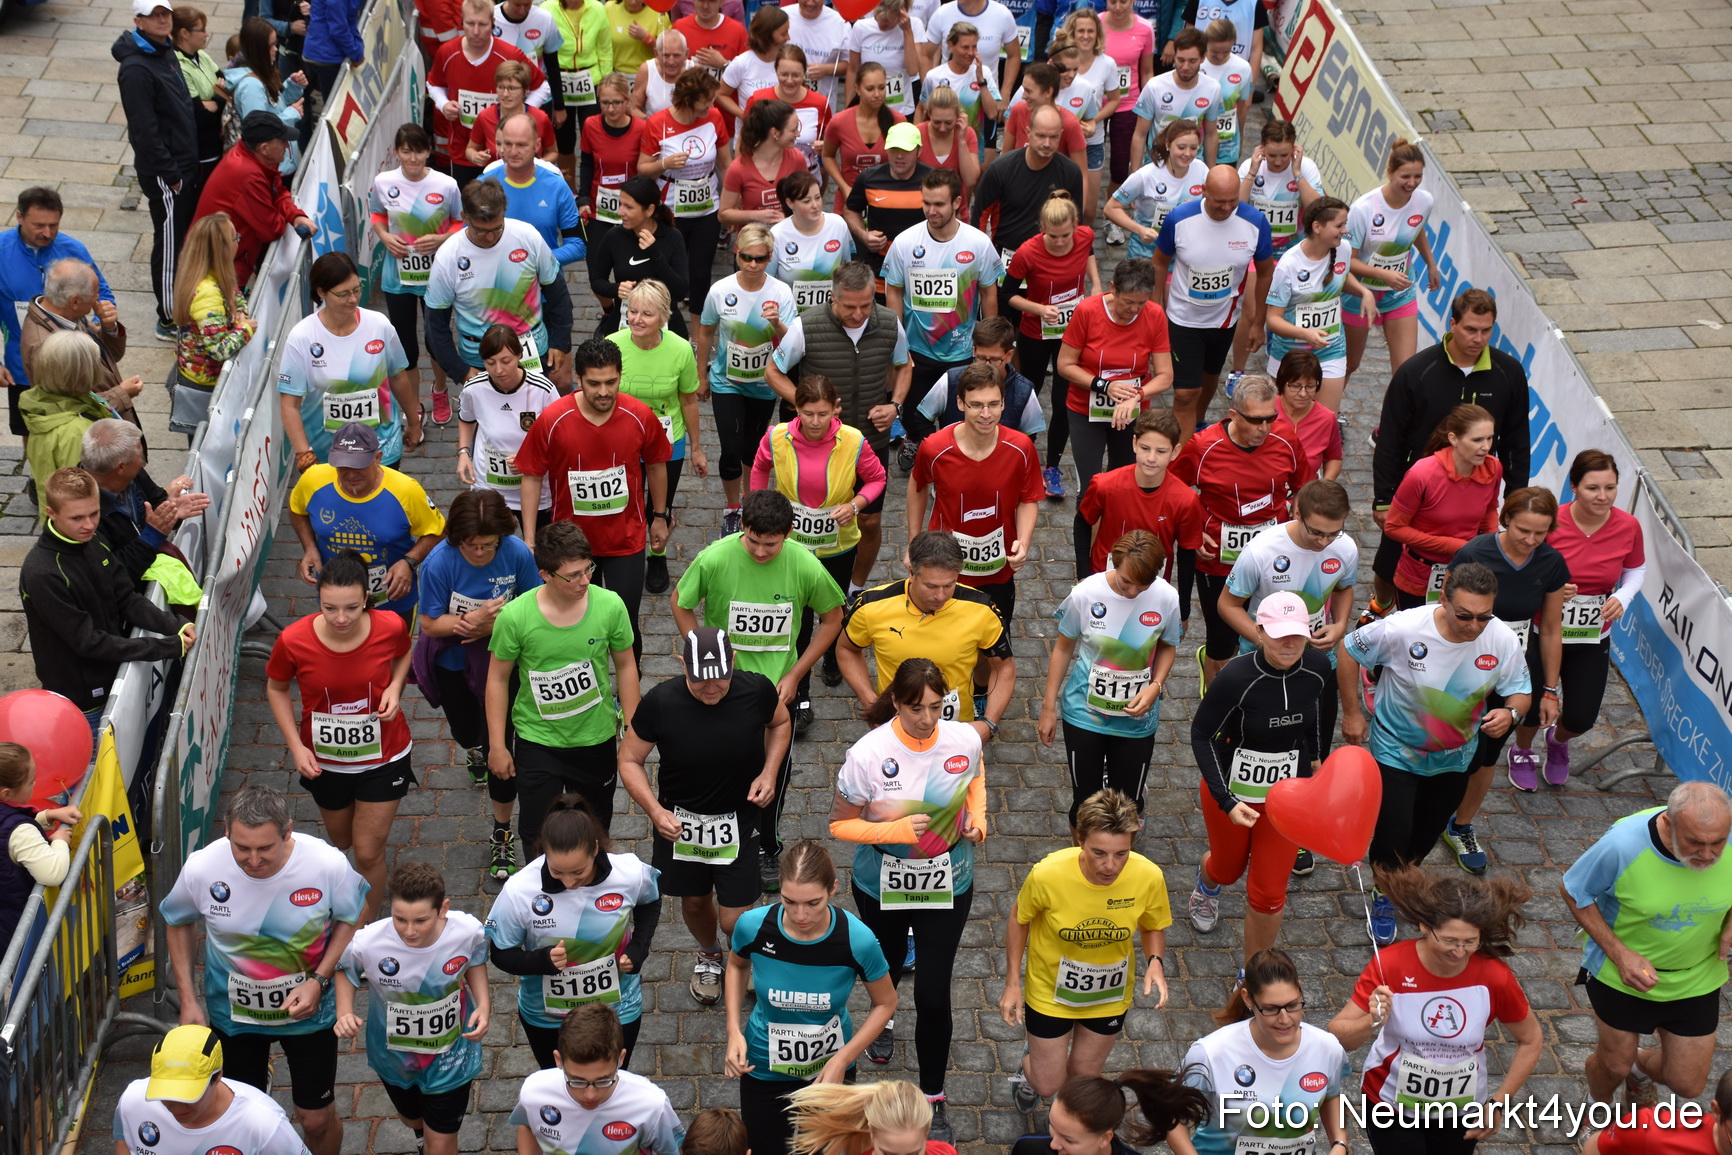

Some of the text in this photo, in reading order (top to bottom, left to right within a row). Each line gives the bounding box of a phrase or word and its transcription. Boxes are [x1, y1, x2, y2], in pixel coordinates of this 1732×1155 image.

[1197, 5, 1221, 19] 66
[560, 79, 591, 93] 5145
[886, 80, 901, 94] 14
[1217, 117, 1232, 131] 36
[1297, 111, 1366, 205] PFLASTERST
[679, 186, 711, 203] 5039
[914, 280, 953, 296] 5025
[1192, 274, 1230, 291] 2535
[796, 290, 833, 305] 5106
[1301, 308, 1337, 329] 5077
[731, 352, 769, 369] 5107
[330, 401, 373, 419] 5041
[340, 438, 356, 446] Speed
[590, 471, 618, 481] Neumarkt
[576, 478, 623, 499] 5102
[592, 502, 611, 510] Saad
[793, 516, 835, 535] 5098
[796, 534, 825, 545] Gislinde
[960, 540, 1000, 562] 5033
[964, 563, 994, 572] Andreas
[1323, 561, 1340, 571] Hervis
[452, 596, 469, 605] PARTL
[735, 615, 788, 634] 5307
[1142, 615, 1160, 623] Hervis
[1659, 581, 1732, 716] RAIL.ON
[1408, 660, 1426, 669] PARTL
[1478, 658, 1496, 667] Hervis
[531, 666, 581, 683] PARTL Neumarkt
[1092, 668, 1141, 681] PARTL Neumarkt
[539, 671, 592, 701] 5306
[1094, 678, 1145, 699] 5117
[1636, 630, 1664, 692] JEDER
[1661, 678, 1711, 766] STRECKE
[341, 704, 359, 712] DEHN
[319, 725, 375, 745] 5088
[336, 749, 359, 757] Anna
[1236, 751, 1288, 765] PARTL Neumarkt
[947, 759, 968, 770] Hervis
[1238, 762, 1291, 784] 5003
[675, 812, 697, 820] PARTL
[681, 821, 733, 846] 5113
[693, 846, 720, 858] Stefan
[883, 860, 941, 871] PARTL Neumarkt
[887, 870, 946, 891] 5072
[294, 891, 319, 902] Hervis
[599, 897, 621, 907] Hervis
[904, 893, 930, 902] Tanja
[210, 905, 231, 913] PARTL
[532, 918, 556, 926] PARTL
[1066, 930, 1124, 940] FRANCESCO
[569, 963, 605, 977] Neumarkt
[1061, 960, 1120, 974] PARTL Neumarkt
[230, 979, 293, 991] PARTL Neumarkt
[378, 977, 401, 985] PARTL
[550, 969, 613, 996] 5186
[1065, 971, 1123, 991] 5310
[768, 988, 830, 1004] HUBER
[389, 1001, 451, 1016] PARTL Neumarkt
[395, 1007, 456, 1036] 5196
[770, 1027, 831, 1039] PARTL Neumarkt
[415, 1038, 439, 1048] Paul
[778, 1033, 839, 1063] 5022
[788, 1061, 826, 1077] Christin
[1402, 1059, 1468, 1077] PARTL Neumarkt
[1303, 1077, 1326, 1087] Hervis
[1406, 1072, 1472, 1098] 5017
[540, 1125, 562, 1137] PARTL
[607, 1125, 633, 1136] Hervis
[1239, 1140, 1305, 1150] PARTL Neumarkt
